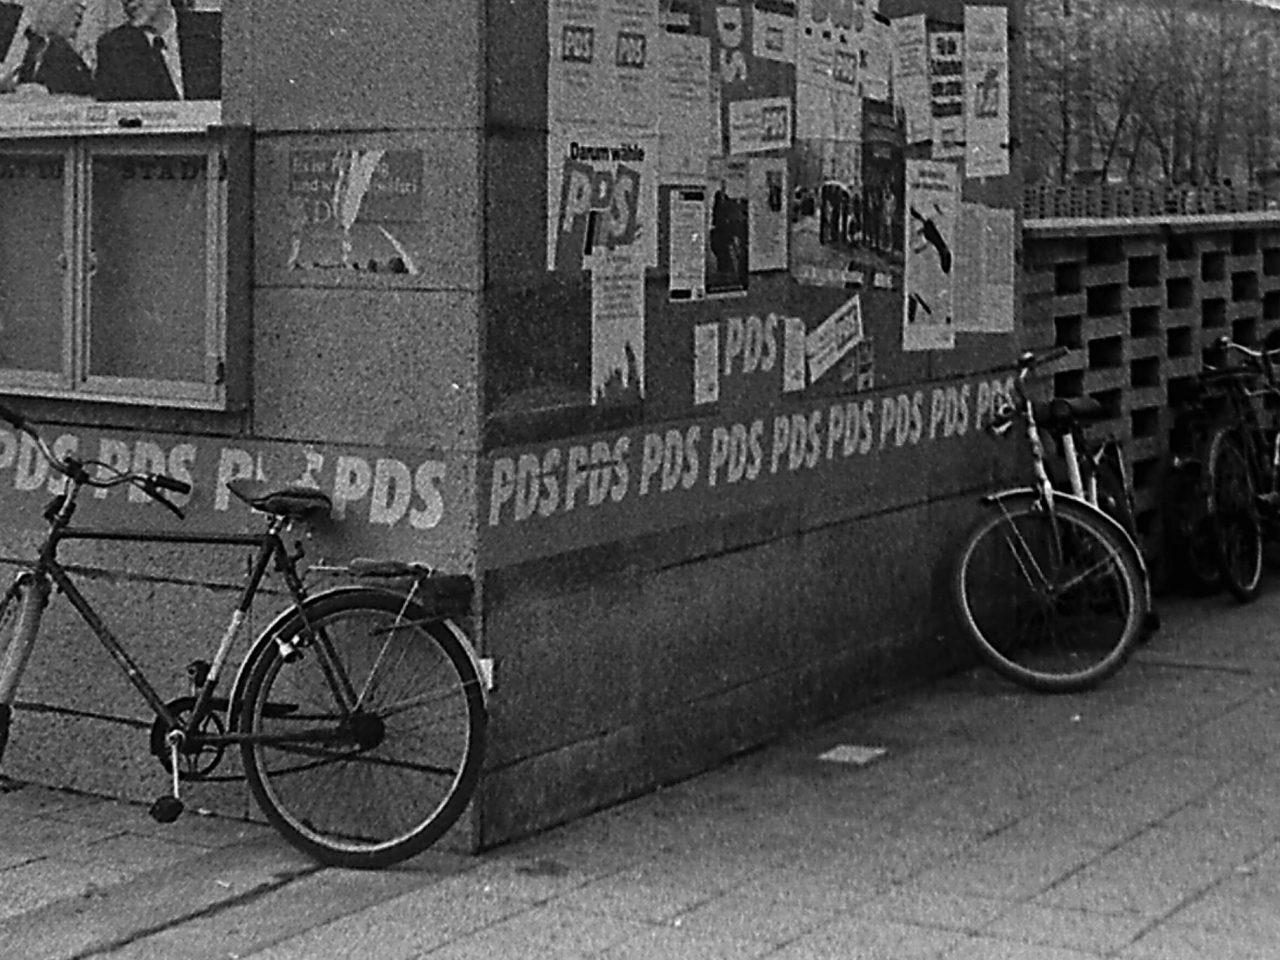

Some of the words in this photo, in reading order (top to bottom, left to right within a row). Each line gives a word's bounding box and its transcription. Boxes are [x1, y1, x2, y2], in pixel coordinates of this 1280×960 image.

[724, 312, 777, 375] PDS
[330, 455, 446, 530] PDS
[488, 448, 562, 526] PDS
[565, 436, 631, 510] PDS
[639, 425, 701, 496] PDS
[708, 419, 764, 486] PDS
[770, 410, 821, 474] PDS
[826, 399, 873, 460] PDS
[879, 391, 923, 449] PDS
[930, 384, 970, 439] PDS
